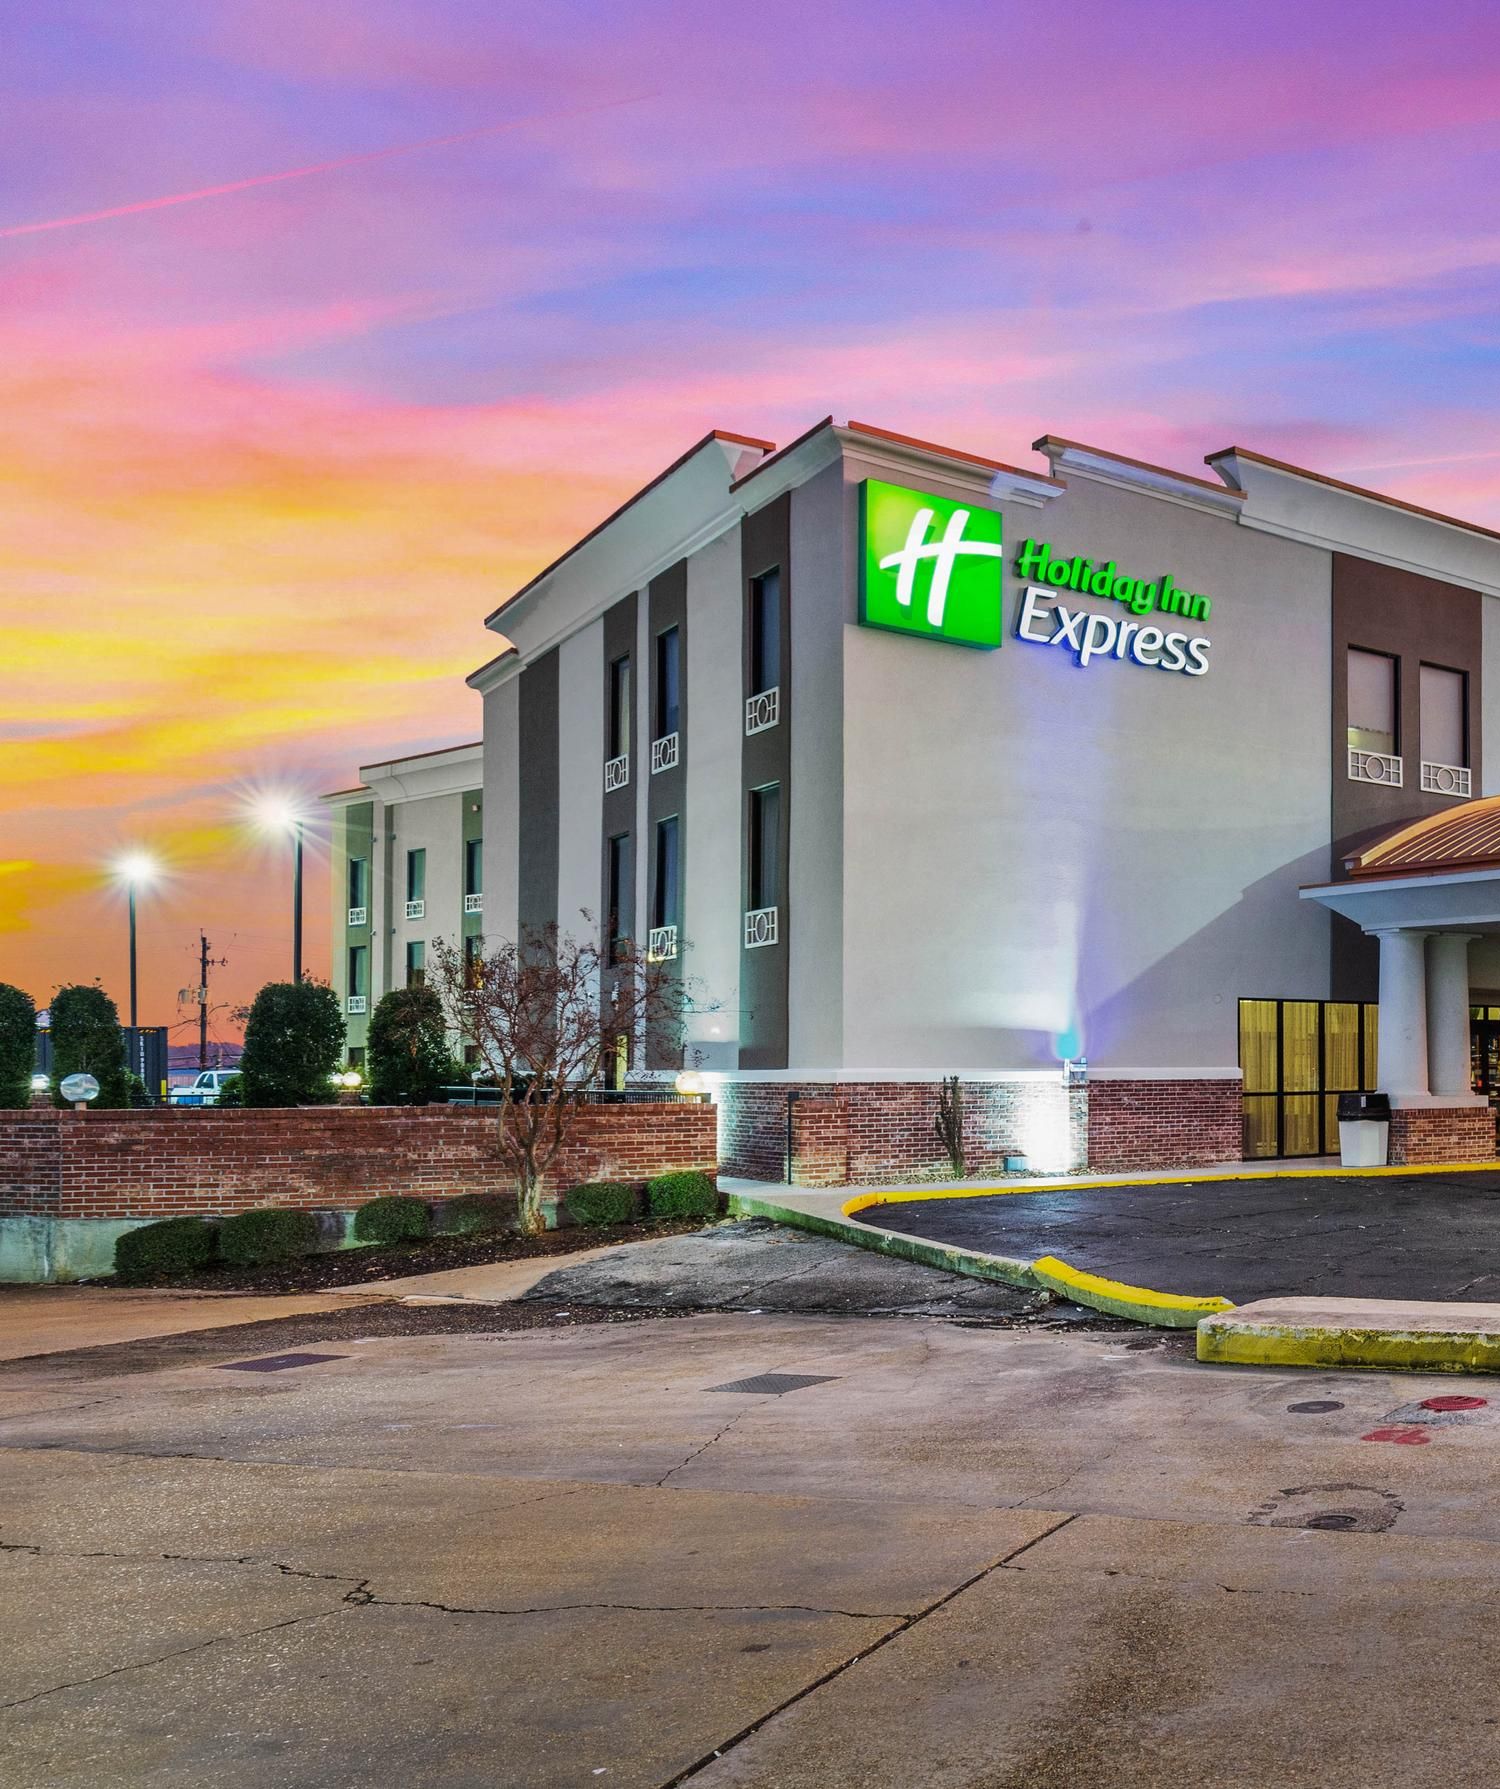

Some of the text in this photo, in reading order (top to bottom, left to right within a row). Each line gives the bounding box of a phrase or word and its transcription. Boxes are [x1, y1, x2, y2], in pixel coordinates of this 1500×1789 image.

[1016, 538, 1212, 621] Holiday Inn
[1015, 585, 1211, 676] Express
